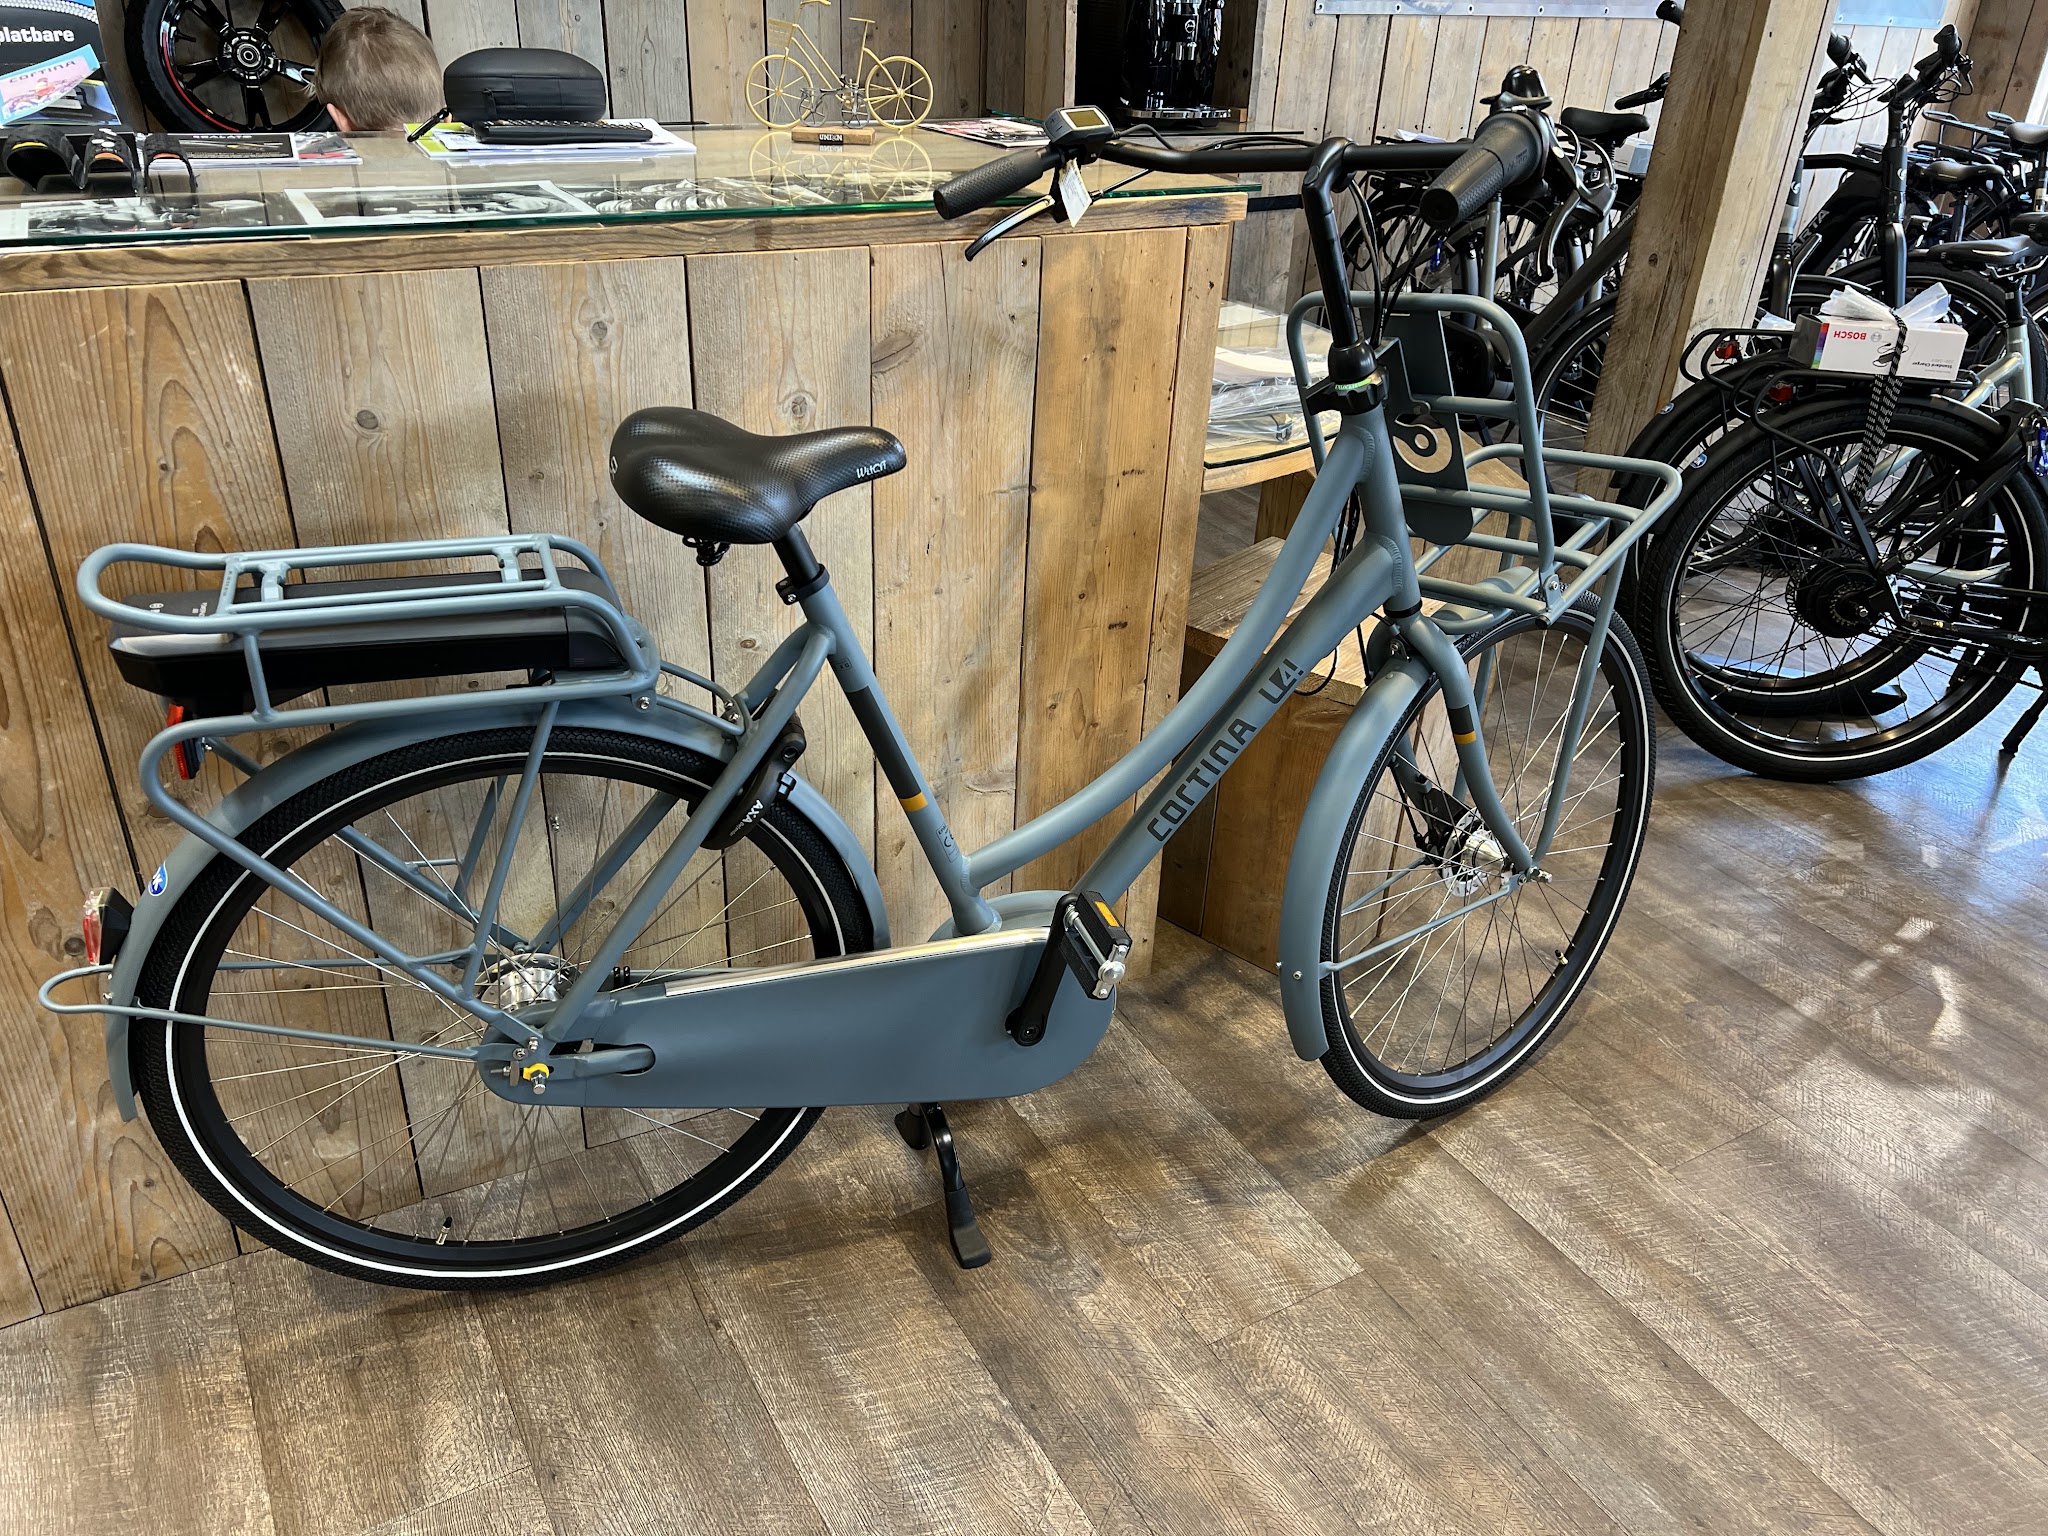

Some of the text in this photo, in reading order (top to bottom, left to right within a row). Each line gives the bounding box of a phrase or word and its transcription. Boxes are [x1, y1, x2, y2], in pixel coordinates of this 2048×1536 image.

[1833, 331, 1867, 341] BOSCH
[1146, 718, 1258, 843] CORTINA
[741, 799, 764, 823] AXA
